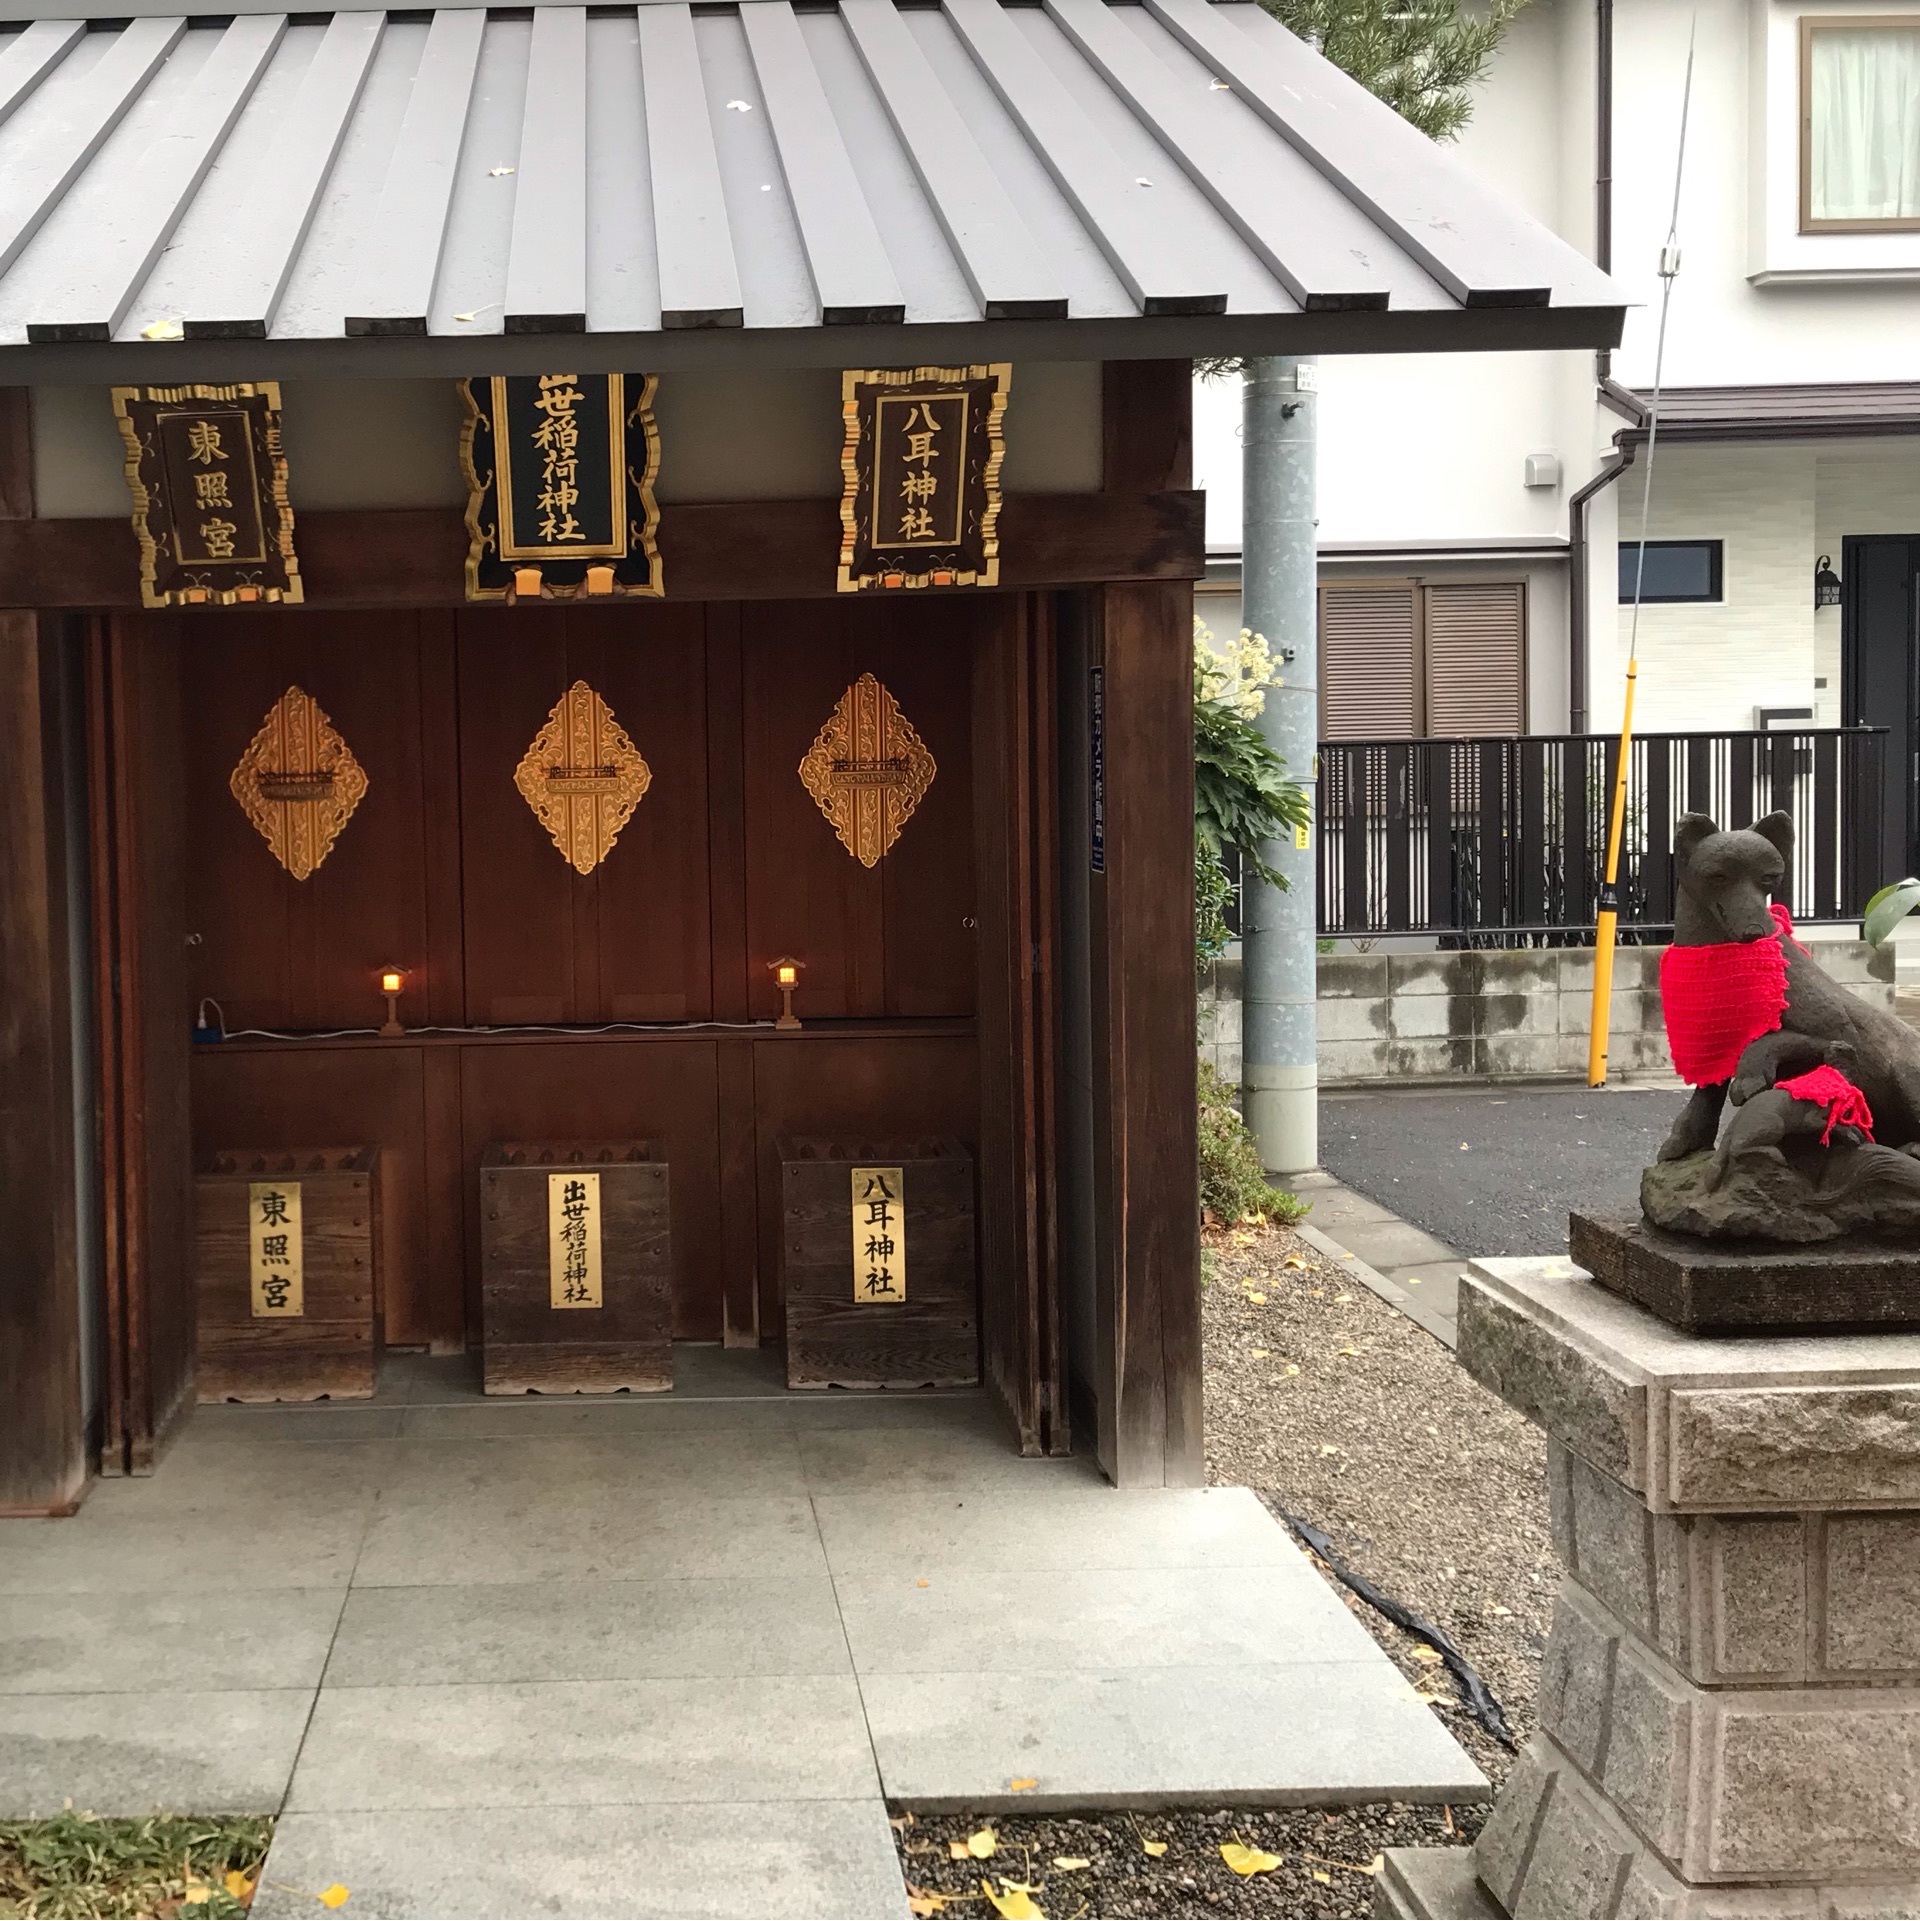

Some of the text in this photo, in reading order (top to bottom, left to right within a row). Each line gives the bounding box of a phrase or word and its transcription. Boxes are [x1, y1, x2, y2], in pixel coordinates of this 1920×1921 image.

[187, 421, 237, 558] 東照宮
[898, 403, 942, 541] 八耳神社
[260, 1191, 292, 1308] 東照宮
[559, 1180, 593, 1303] 出世稲荷神社
[862, 1174, 896, 1297] 八耳神社
